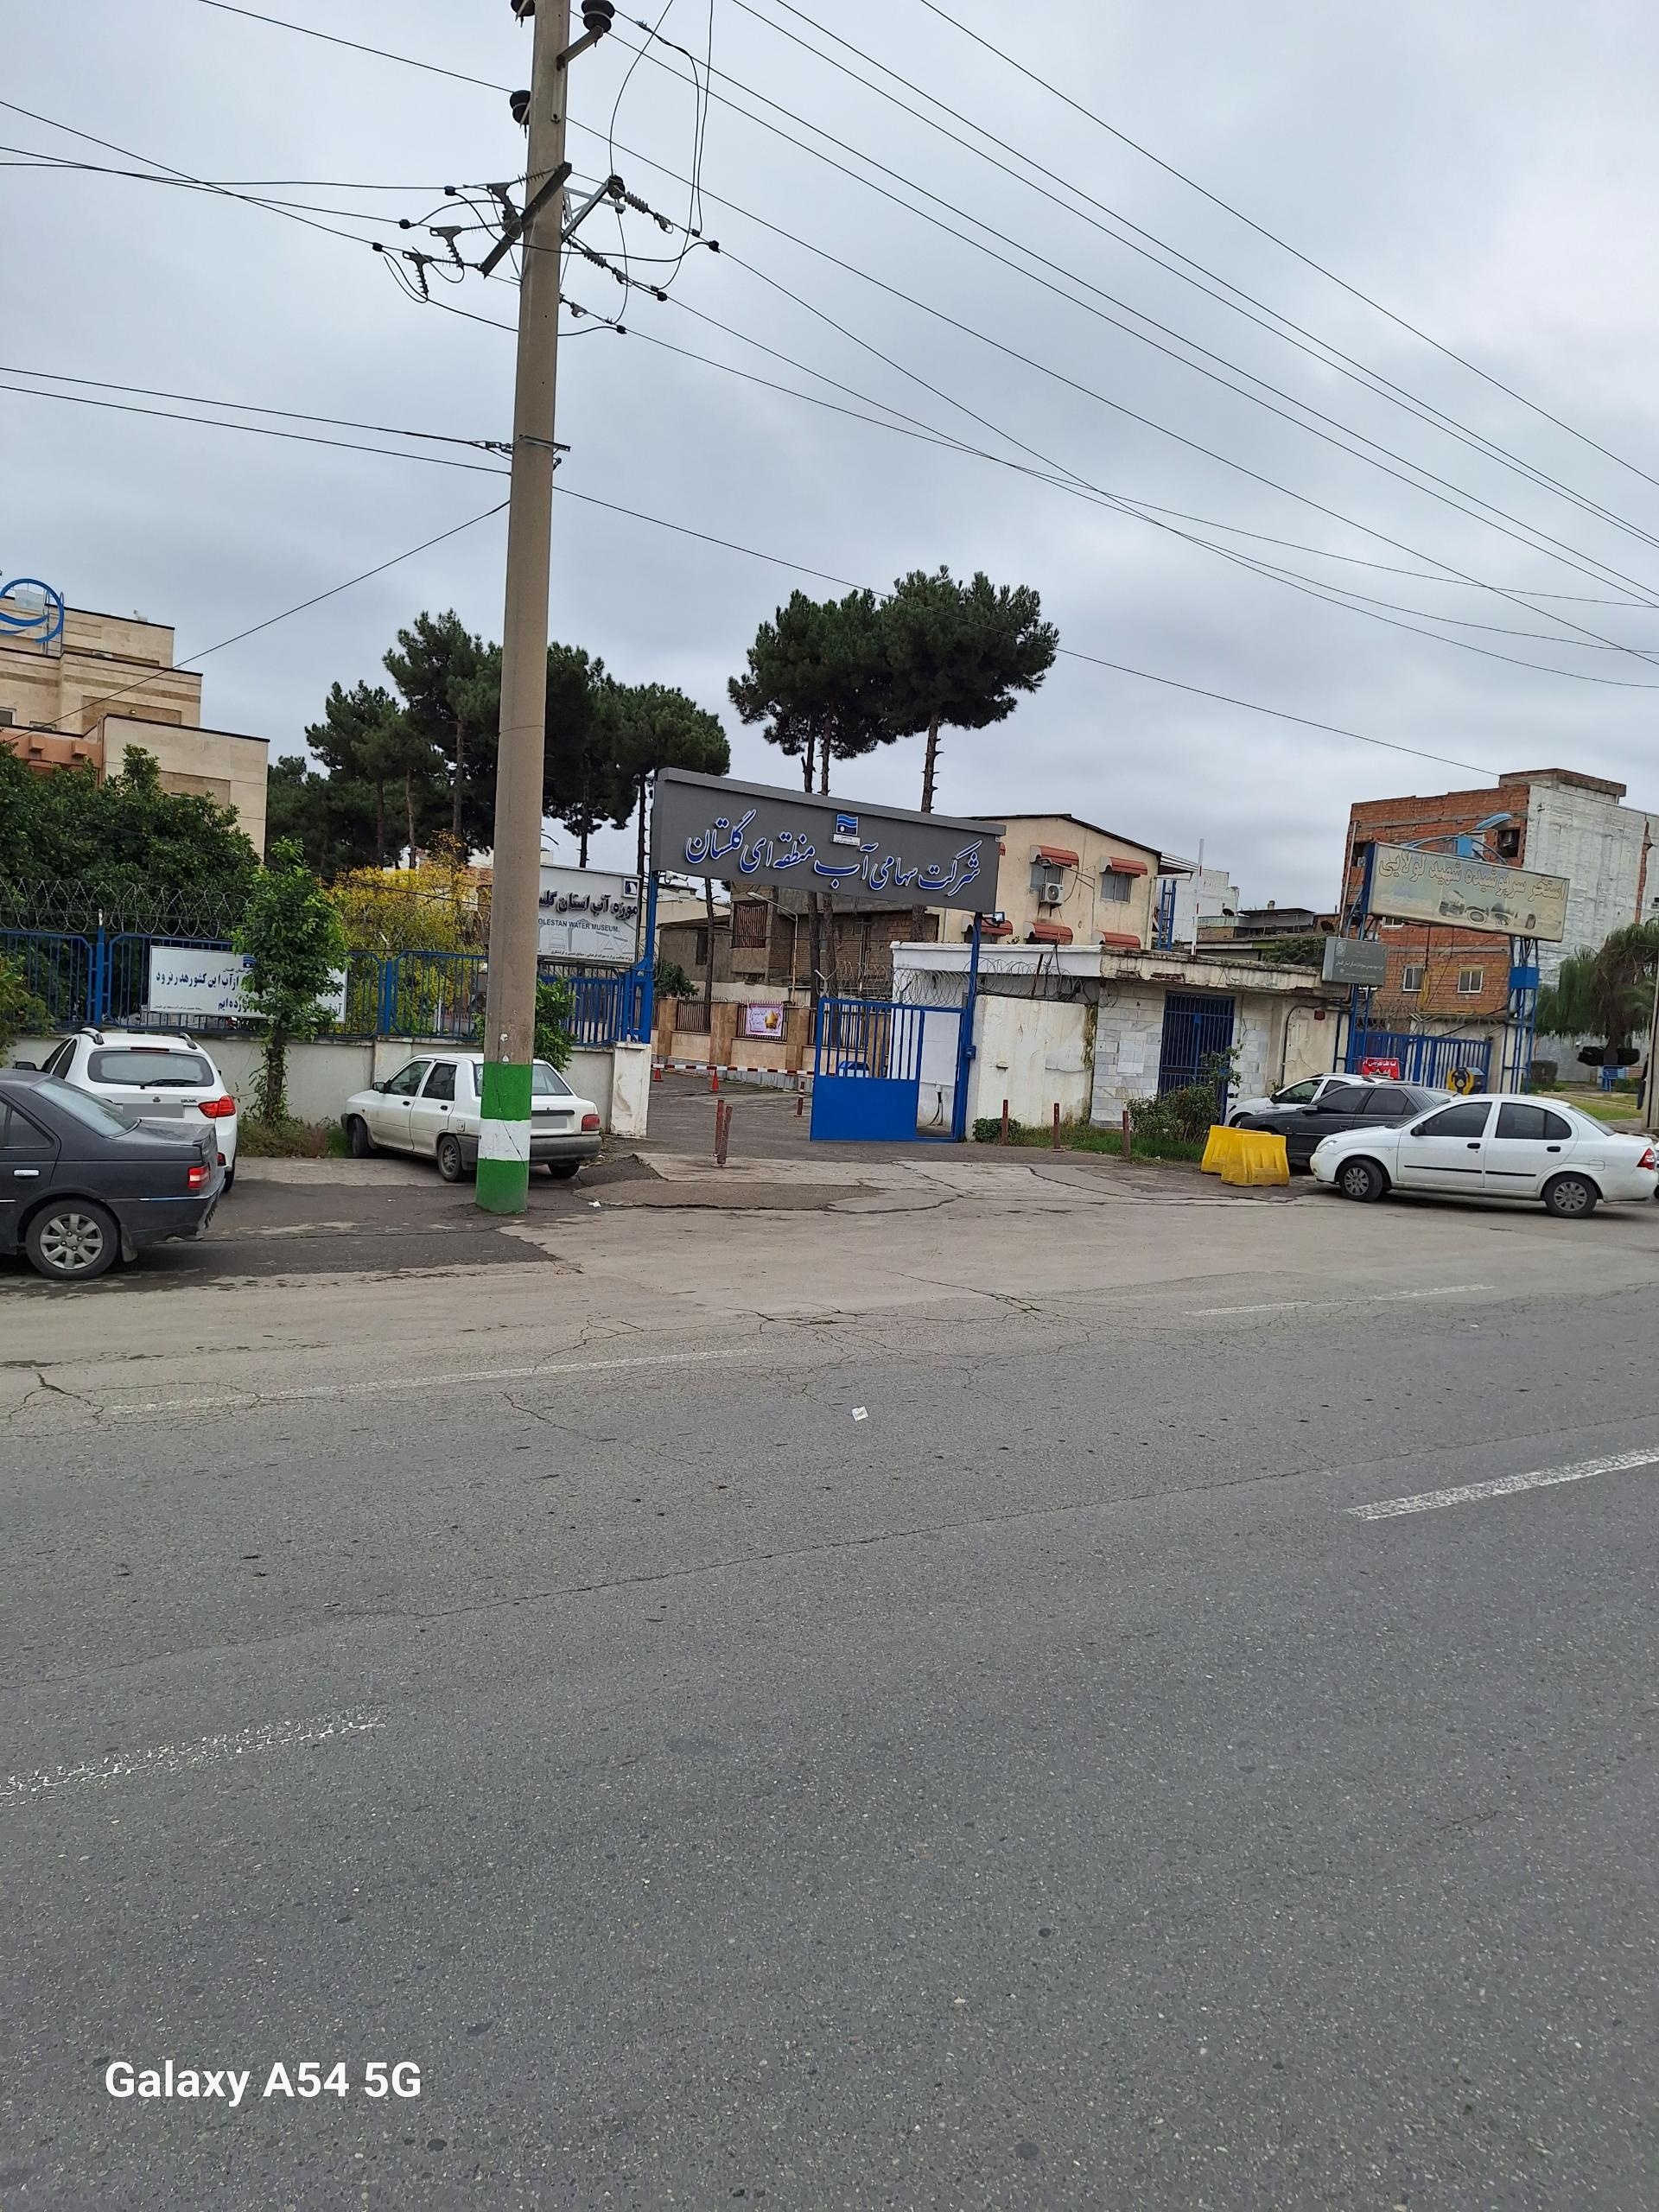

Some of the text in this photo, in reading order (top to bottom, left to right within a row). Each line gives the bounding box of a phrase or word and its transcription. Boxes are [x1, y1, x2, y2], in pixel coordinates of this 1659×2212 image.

[685, 809, 982, 897] شرکت سهامی آب منطقه ای گلستان
[1428, 859, 1464, 886] شهید
[1527, 874, 1568, 903] استخر
[556, 892, 590, 914] استان
[590, 893, 612, 917] آب
[610, 901, 639, 921] موزه
[537, 918, 619, 932] OLESTAN WATER MUSEUM
[156, 970, 174, 986] نرود
[174, 972, 189, 986] هدر
[188, 972, 207, 988] کشور
[207, 973, 221, 988] این
